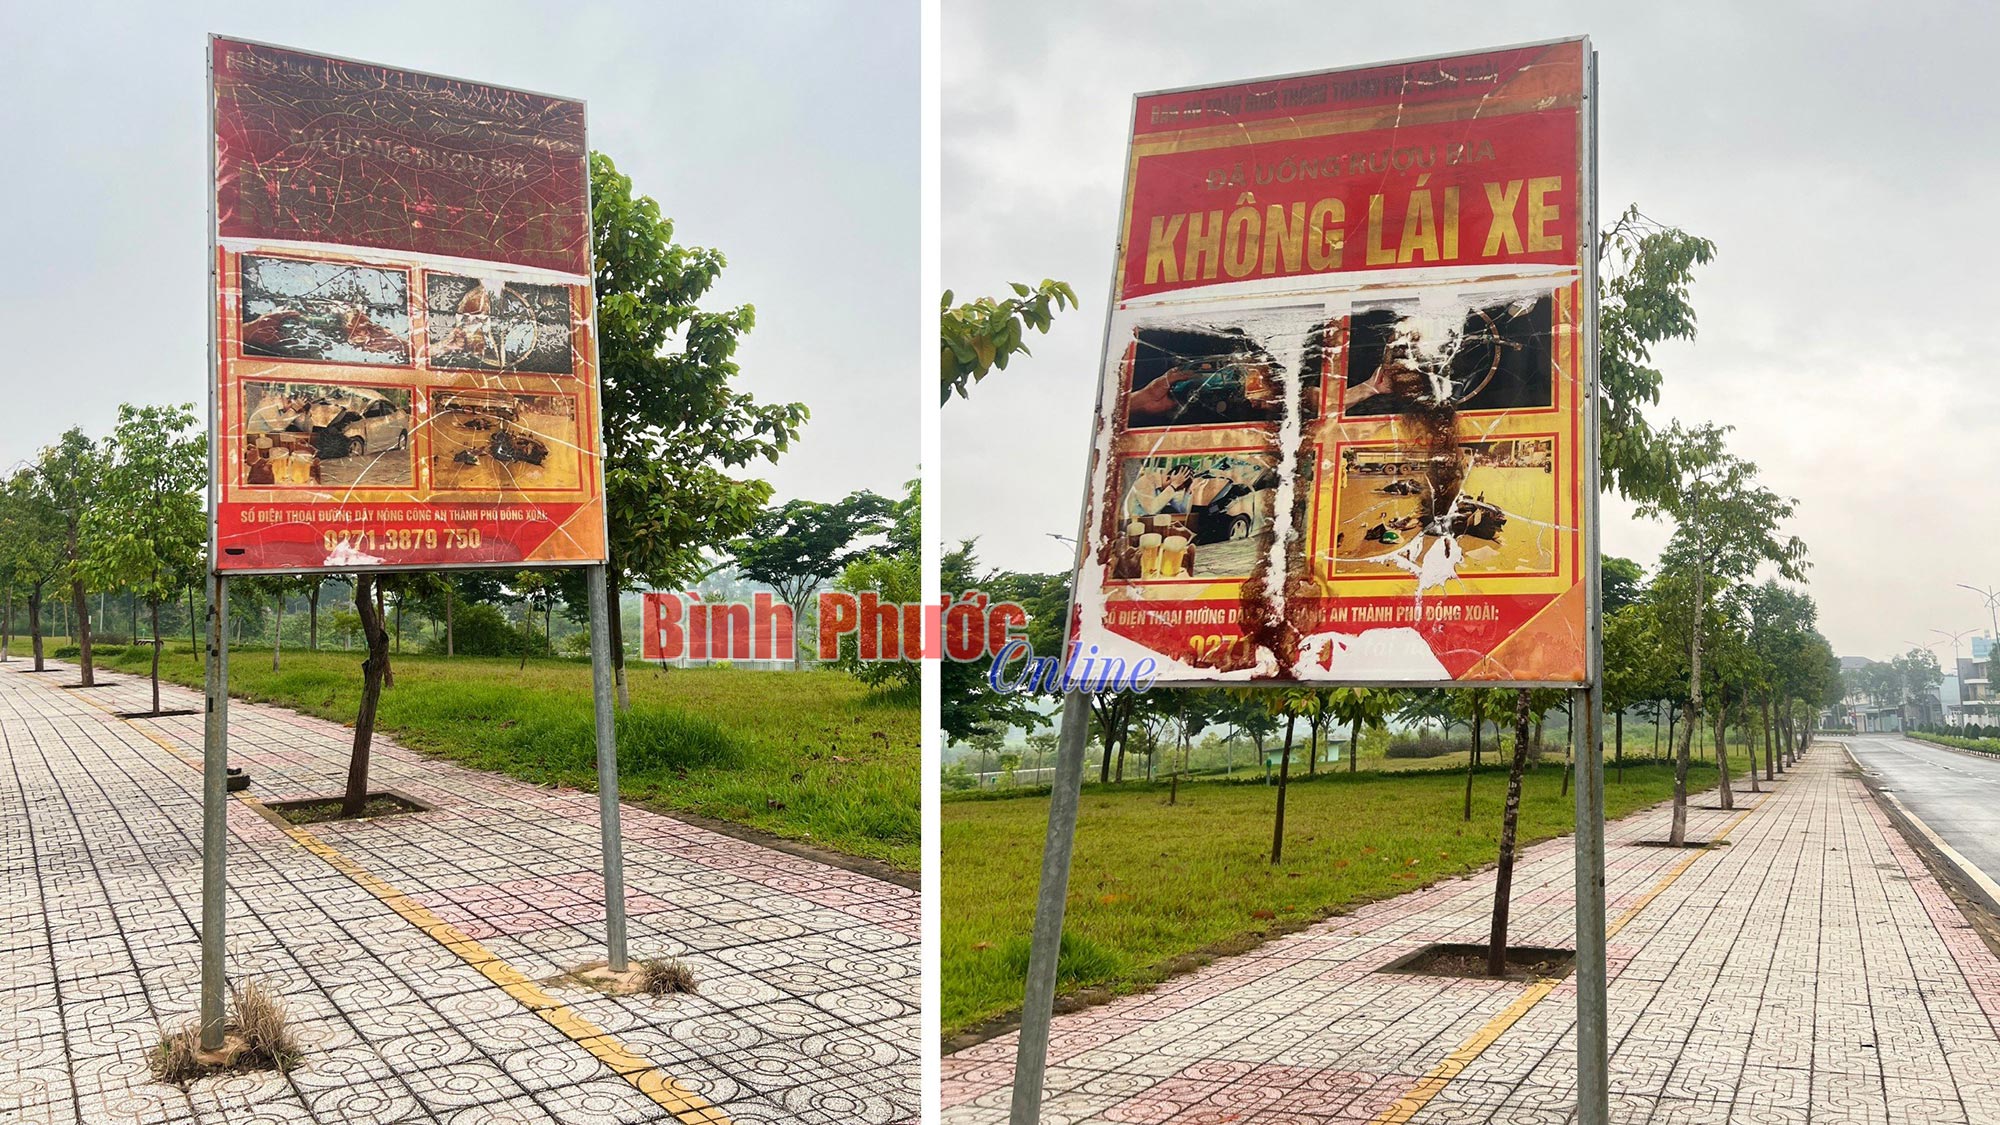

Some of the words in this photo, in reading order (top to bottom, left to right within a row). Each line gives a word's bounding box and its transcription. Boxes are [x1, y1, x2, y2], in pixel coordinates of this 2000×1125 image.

[1207, 161, 1246, 191] ĐÃ
[1254, 154, 1341, 186] UỐNG
[1349, 145, 1436, 177] RƯỢU
[1445, 139, 1497, 165] BIA
[1144, 191, 1345, 285] KHÔNG
[1366, 173, 1460, 266] LÁI
[1482, 175, 1563, 257] XE
[241, 507, 255, 522] SỐ
[258, 507, 283, 525] ĐIỆN
[286, 509, 316, 525] THOẠI
[319, 508, 352, 523] ĐƯỜNG
[377, 507, 403, 522] NÓNG
[406, 507, 432, 522] CÔNG
[450, 507, 478, 521] THÀNH
[481, 506, 498, 521] PHỐ
[501, 505, 524, 520] ĐỒNG
[443, 528, 482, 549] 750
[1119, 607, 1146, 627] ĐIỆN
[1185, 605, 1225, 625] ĐƯỜNG
[1329, 606, 1348, 622] AN
[1351, 603, 1393, 622] THÀNH
[1426, 601, 1462, 621] ĐỒNG
[1465, 602, 1500, 621] XOÀI:
